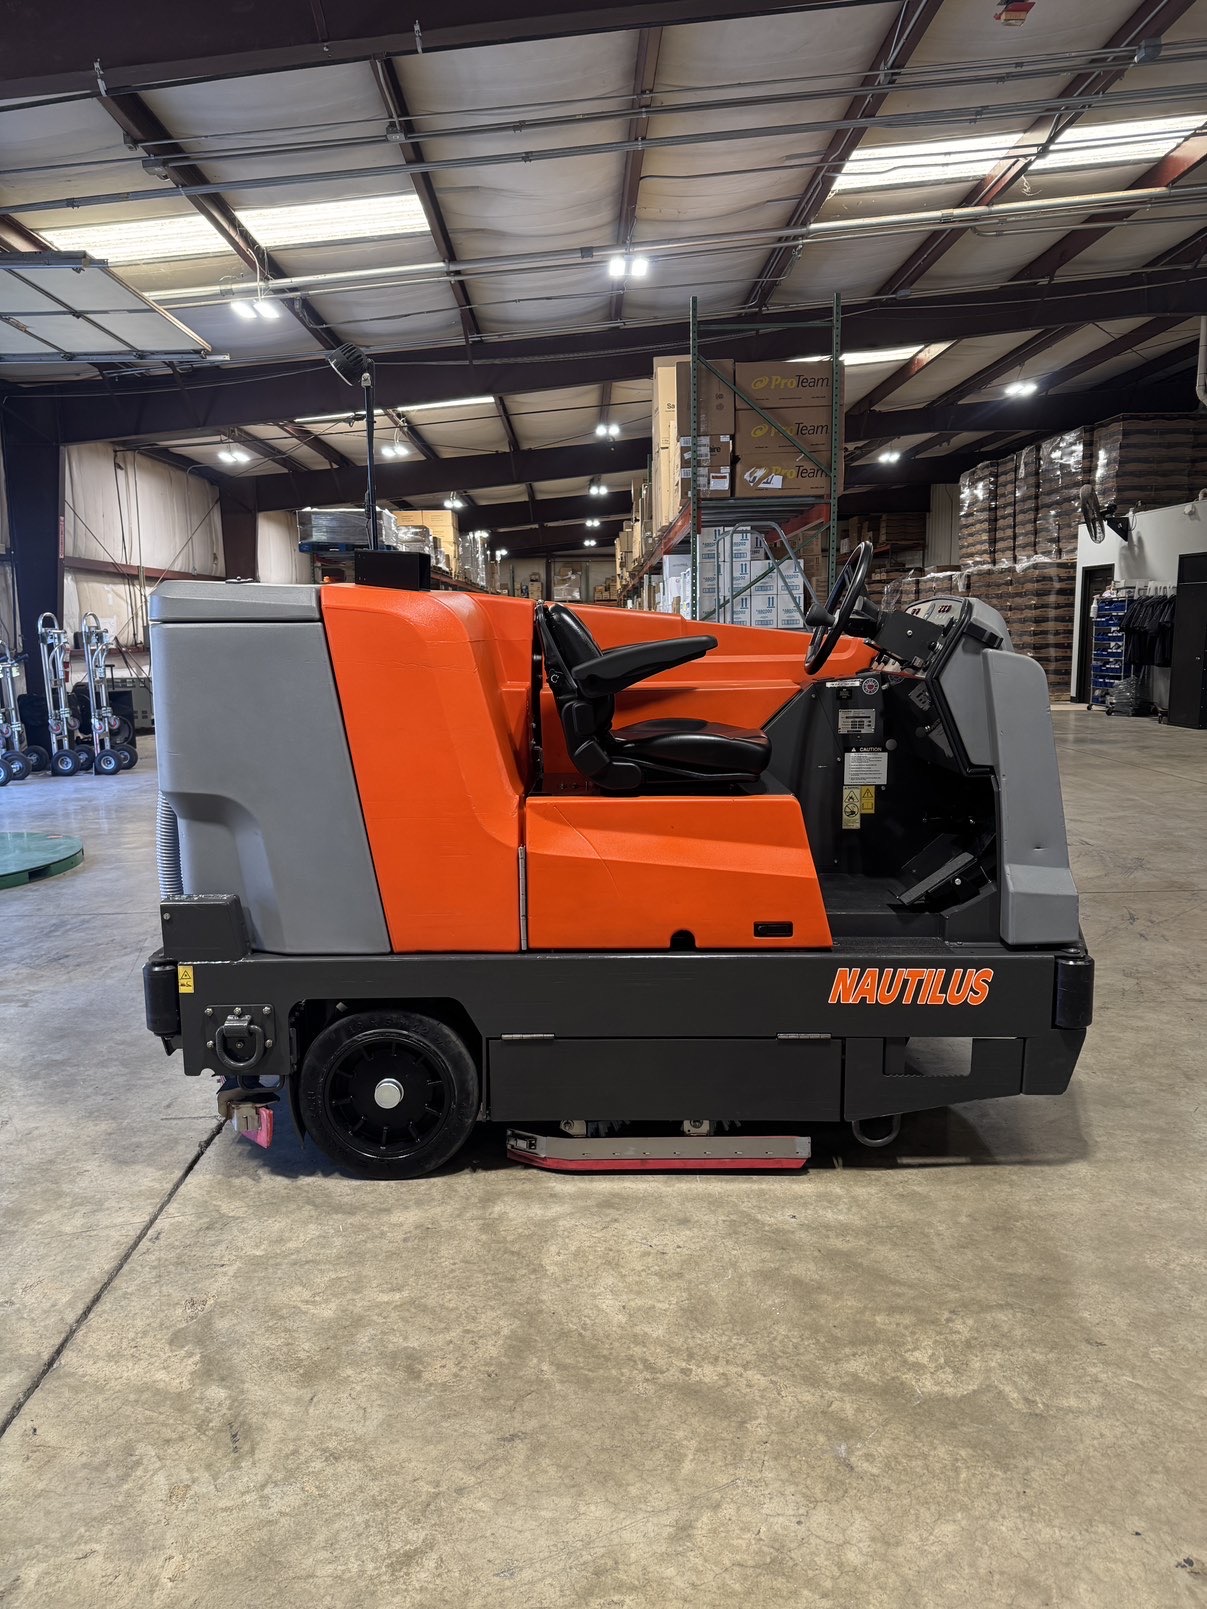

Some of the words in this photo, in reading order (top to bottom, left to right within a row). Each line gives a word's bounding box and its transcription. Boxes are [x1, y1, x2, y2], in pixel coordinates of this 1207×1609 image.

[770, 374, 829, 389] ProTeam
[770, 422, 829, 437] oTeam
[828, 968, 994, 1005] NAUTILUS
